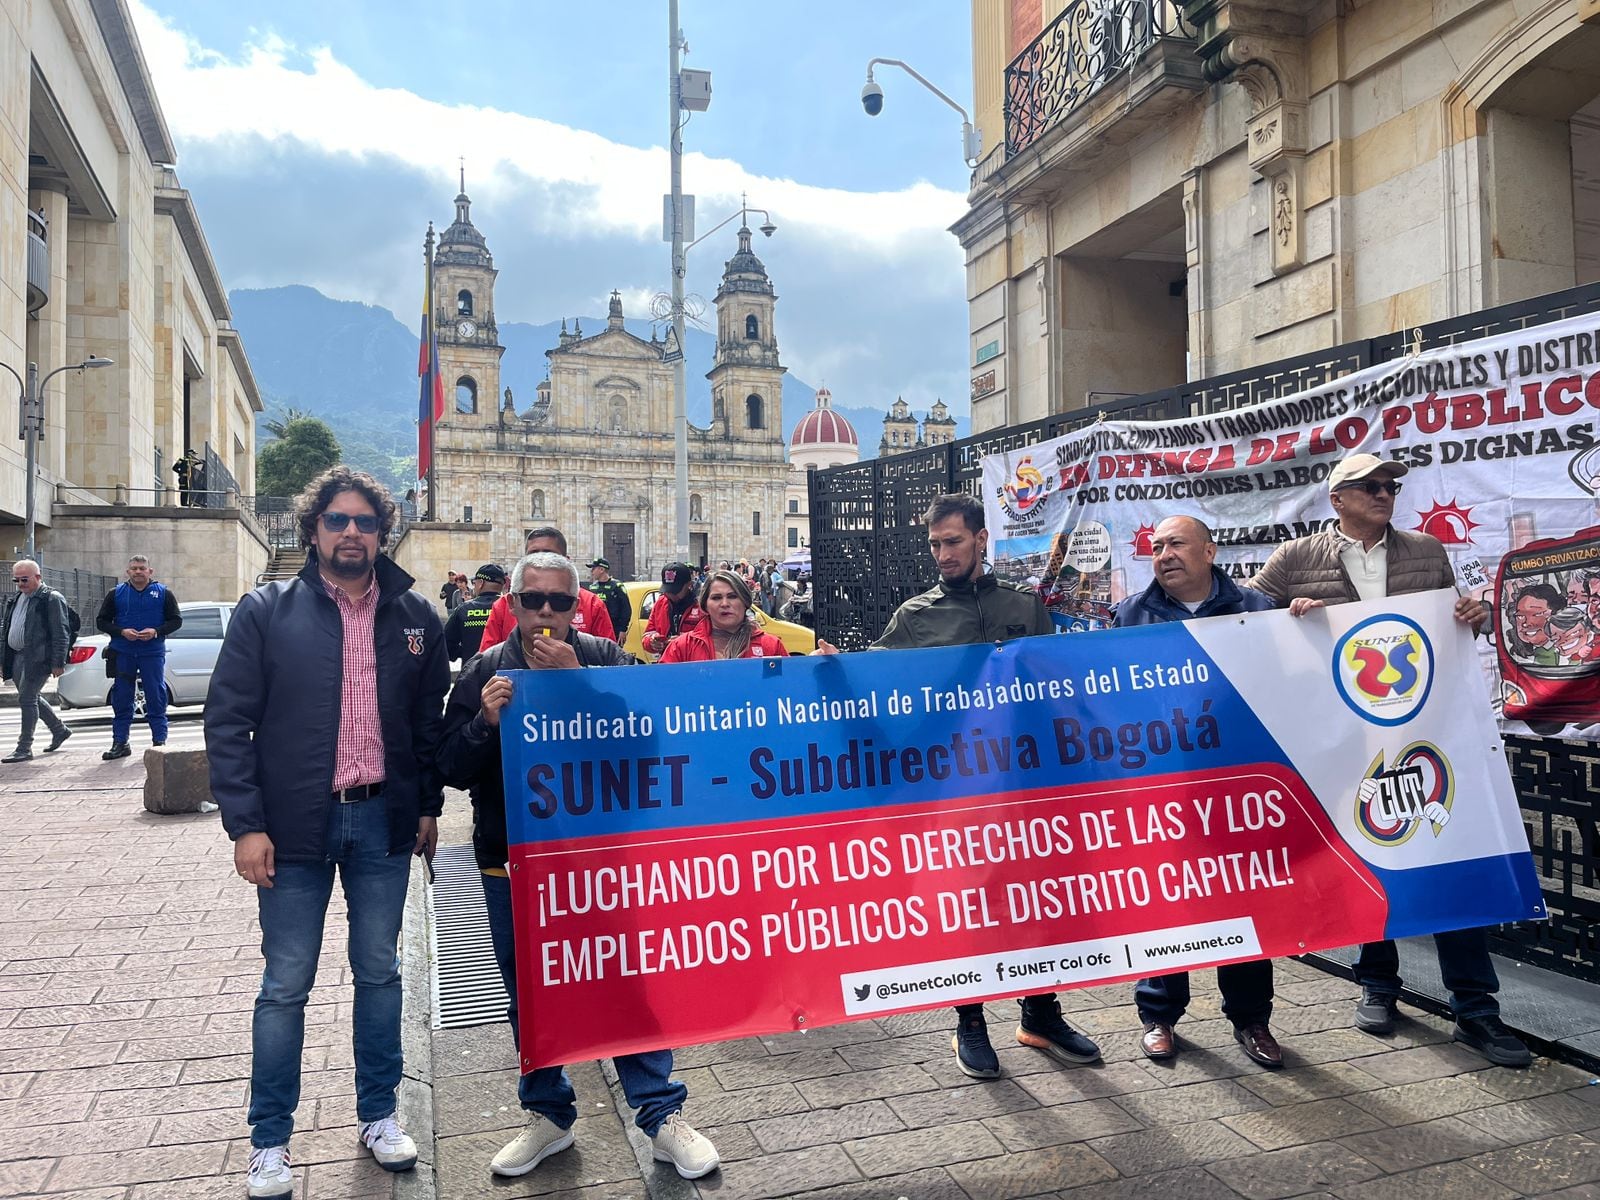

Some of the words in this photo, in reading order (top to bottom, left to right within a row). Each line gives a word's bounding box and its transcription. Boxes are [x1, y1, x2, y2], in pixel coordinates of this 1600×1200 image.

[1056, 431, 1109, 465] SINDICATO
[1127, 422, 1205, 450] EMPLEADOS
[1203, 420, 1216, 442] Y
[1216, 389, 1348, 440] TRABAJADORES
[1353, 354, 1488, 410] NACIONALES
[1495, 349, 1509, 380] Y
[1059, 461, 1090, 490] EN
[1098, 444, 1236, 479] DEFENSA
[1246, 432, 1300, 466] DE
[1309, 417, 1368, 455] LO
[1077, 486, 1110, 506] POR
[1115, 475, 1253, 500] CONDICIONES
[1439, 422, 1594, 464] DIGNAS
[1089, 546, 1109, 554] ciudad
[1461, 560, 1481, 573] HOJA
[1464, 570, 1474, 579] DE
[1467, 575, 1485, 587] VIDA
[1511, 557, 1544, 571] RUMBO
[1353, 633, 1414, 648] SUNET
[523, 711, 653, 742] Sindicato
[664, 701, 767, 734] Unitario
[778, 690, 877, 724] Nacional
[887, 689, 913, 715] de
[921, 677, 1074, 712] Trabajadores
[1084, 667, 1120, 696] del
[1129, 658, 1209, 690] Estado
[526, 754, 690, 820] SUNET
[749, 728, 1041, 799] Subdirectiva
[1053, 699, 1221, 770] Bogotá
[1377, 772, 1425, 821] CUT
[537, 853, 740, 927] ¡LUCHANDO
[752, 845, 820, 892] POR
[829, 836, 892, 883] LOS
[900, 815, 1074, 874] DERECHOS
[1080, 809, 1121, 851] DE
[1126, 802, 1186, 846] LAS
[1193, 797, 1214, 836] Y
[1225, 790, 1287, 833] LOS
[542, 917, 751, 986] EMPLEADOS
[760, 898, 929, 957] PÚBLICOS
[936, 888, 999, 933] DEL
[1006, 866, 1151, 924] DISTRITO
[1157, 847, 1294, 901] CAPITAL!
[875, 970, 982, 999] @SunetColOfc
[1008, 960, 1056, 978] SUNET
[1060, 957, 1083, 972] Col
[1087, 952, 1112, 967] Ofc
[1144, 933, 1244, 958] www.sunet.co
